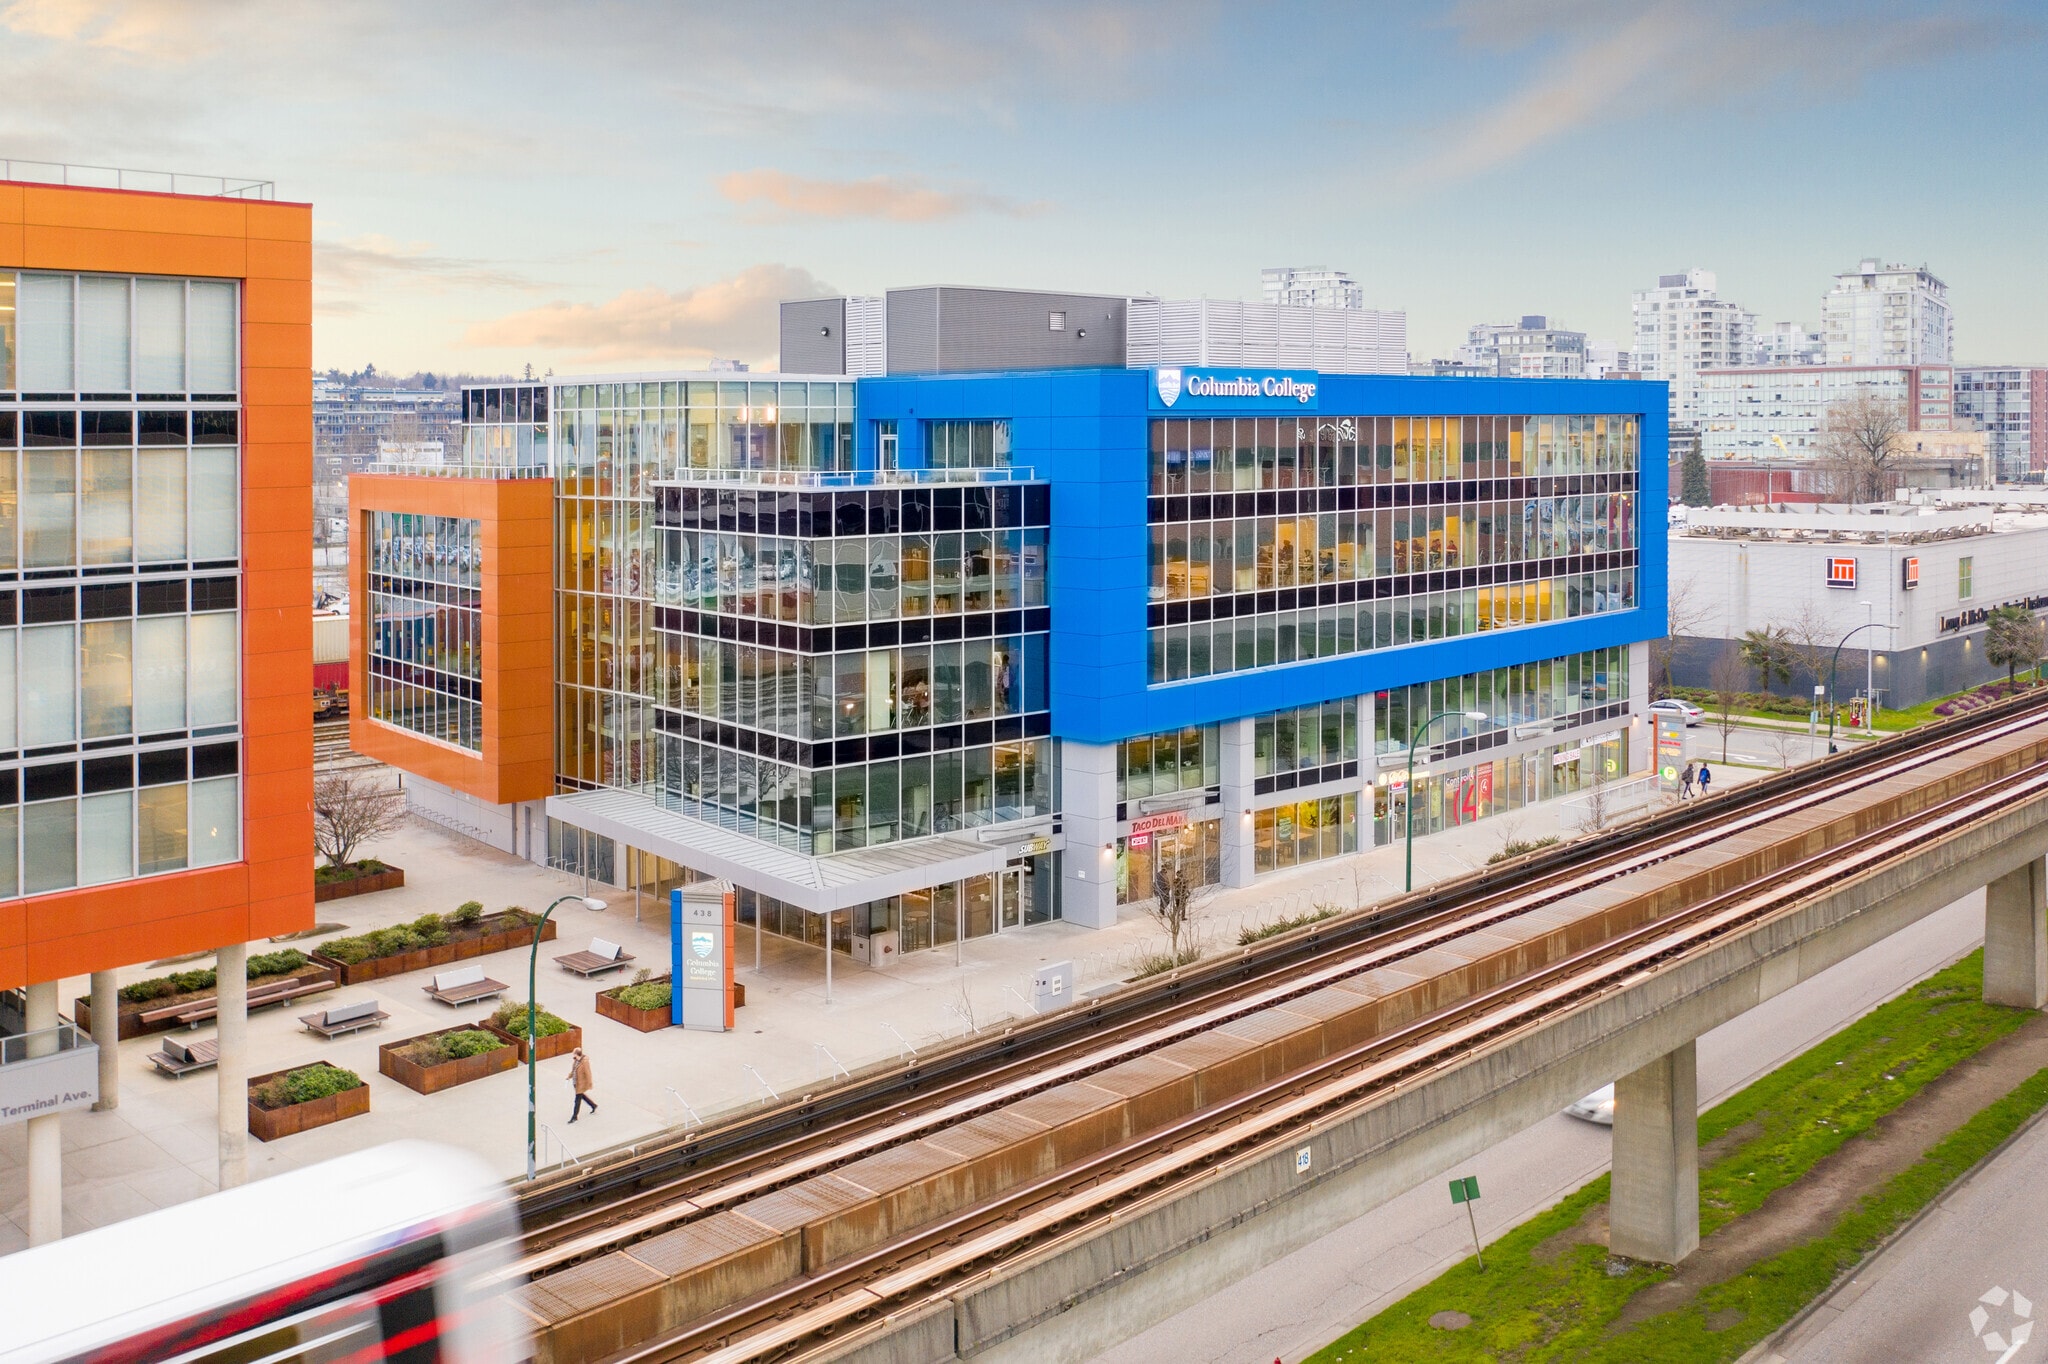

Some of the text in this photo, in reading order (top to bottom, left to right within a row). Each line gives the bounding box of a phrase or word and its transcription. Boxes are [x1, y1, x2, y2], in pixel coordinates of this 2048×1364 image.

[1188, 375, 1316, 403] Columbia College
[1132, 820, 1152, 833] TACO
[1152, 818, 1165, 828] DEL
[1018, 840, 1050, 854] SUBWAY
[693, 909, 712, 917] 438
[686, 958, 720, 967] Columbia
[690, 966, 717, 977] College
[1, 1091, 92, 1117] Terminal Ave.
[1297, 1151, 1309, 1166] 418
